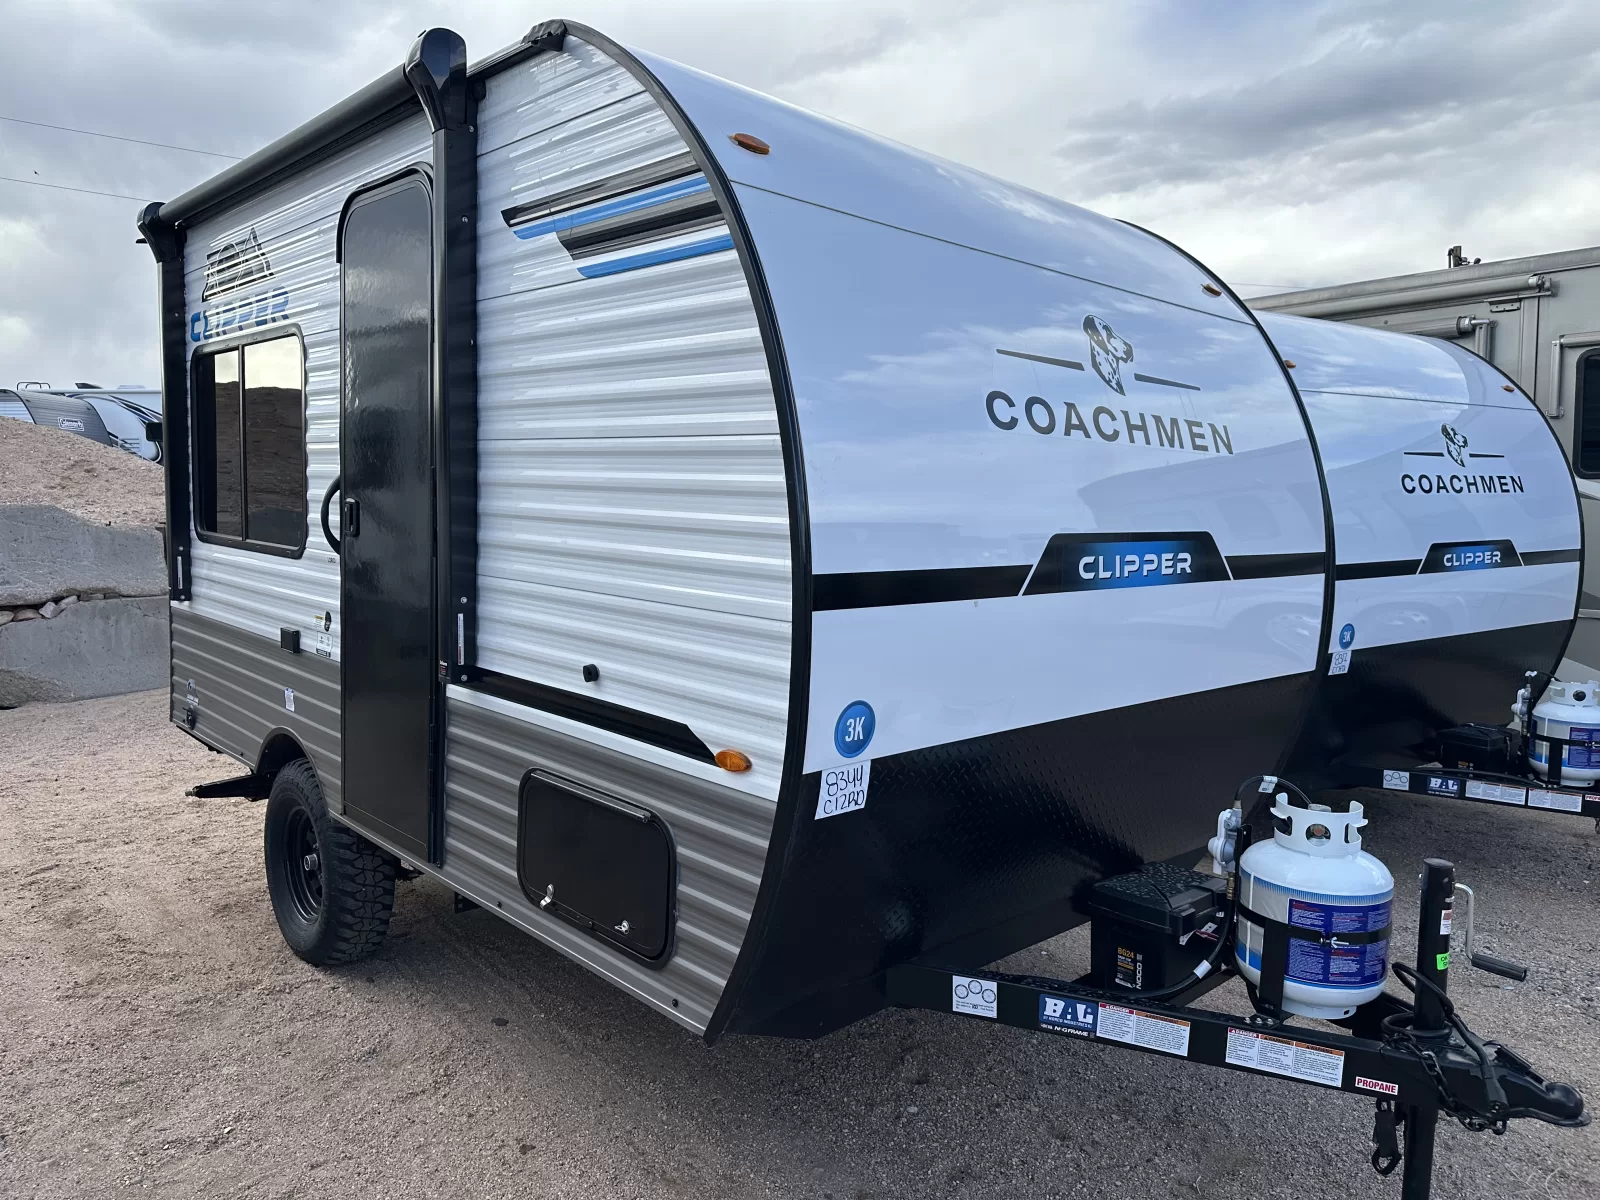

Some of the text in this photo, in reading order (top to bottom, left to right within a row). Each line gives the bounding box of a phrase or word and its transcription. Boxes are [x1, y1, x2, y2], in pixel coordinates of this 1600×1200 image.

[190, 286, 290, 343] CLIPPER
[985, 390, 1234, 455] COACHMEN
[1401, 473, 1525, 494] COACHMEN
[1078, 552, 1192, 580] CLIPPER
[1443, 551, 1502, 567] CLIPPER
[1342, 630, 1352, 643] 3K
[844, 716, 866, 742] 3K
[825, 764, 864, 797] 8344
[1043, 997, 1094, 1024] BAL
[1356, 1077, 1397, 1094] PROPANE
